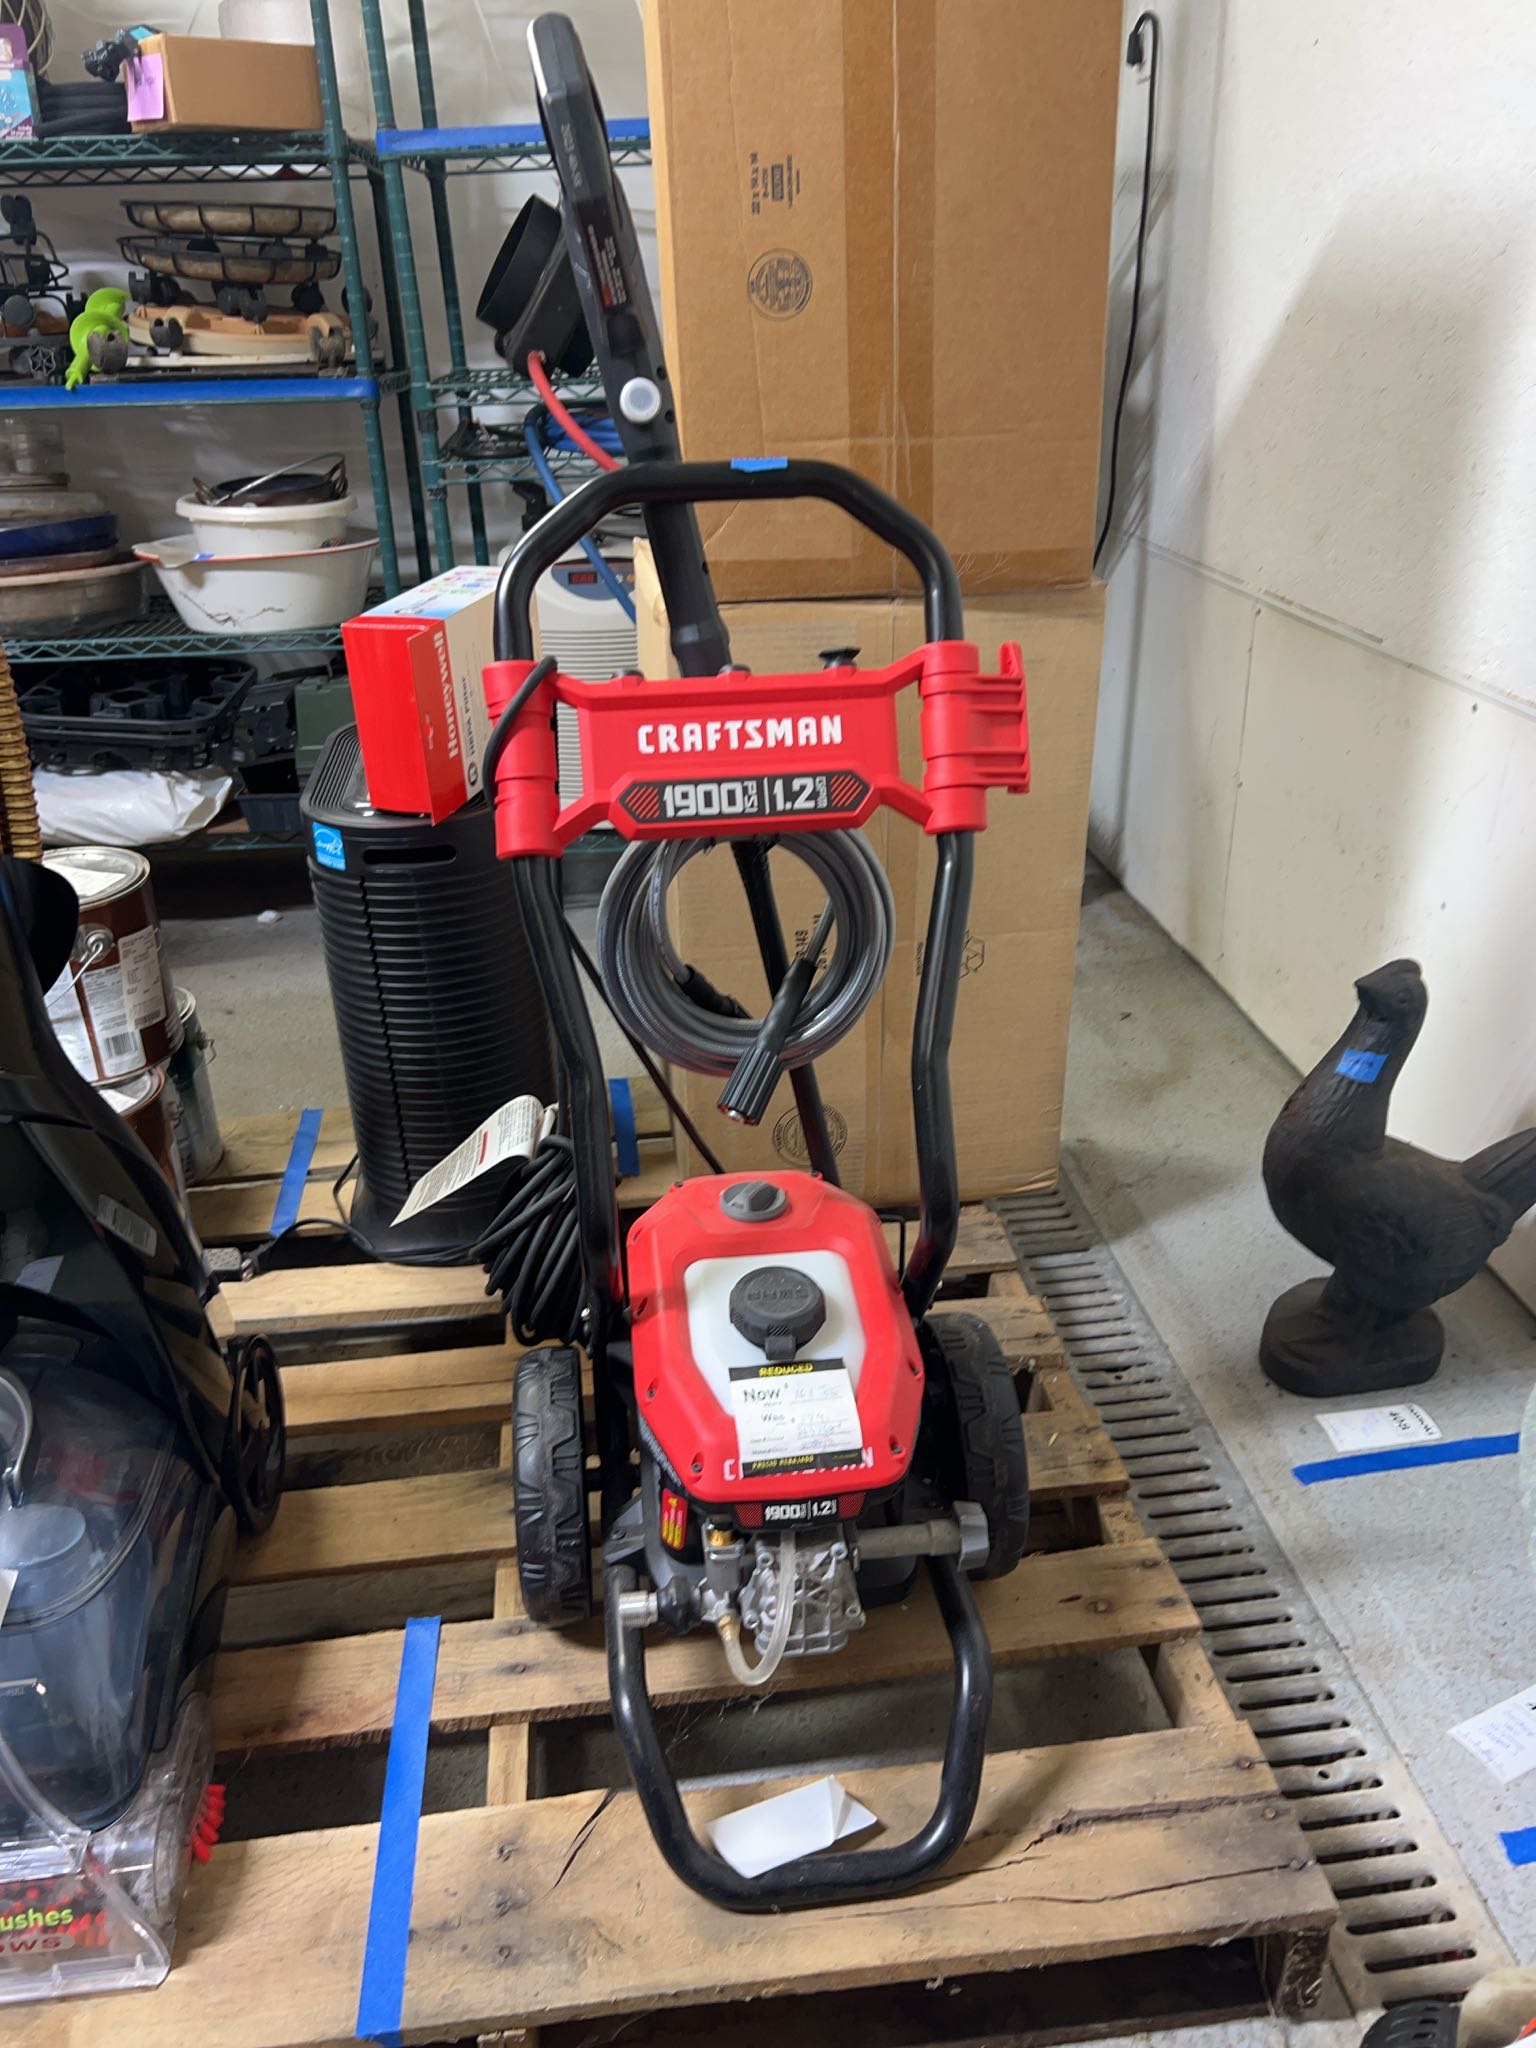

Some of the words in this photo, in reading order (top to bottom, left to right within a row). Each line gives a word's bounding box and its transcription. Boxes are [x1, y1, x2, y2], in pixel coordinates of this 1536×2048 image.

[433, 631, 458, 760] Honeywell
[637, 714, 843, 755] CRAFTSMAN
[662, 781, 744, 819] 1900
[743, 780, 759, 814] PSI
[772, 776, 816, 812] 1.2
[759, 1363, 813, 1377] REDUCED
[764, 1504, 801, 1521] 1900
[812, 1500, 832, 1517] 1.2
